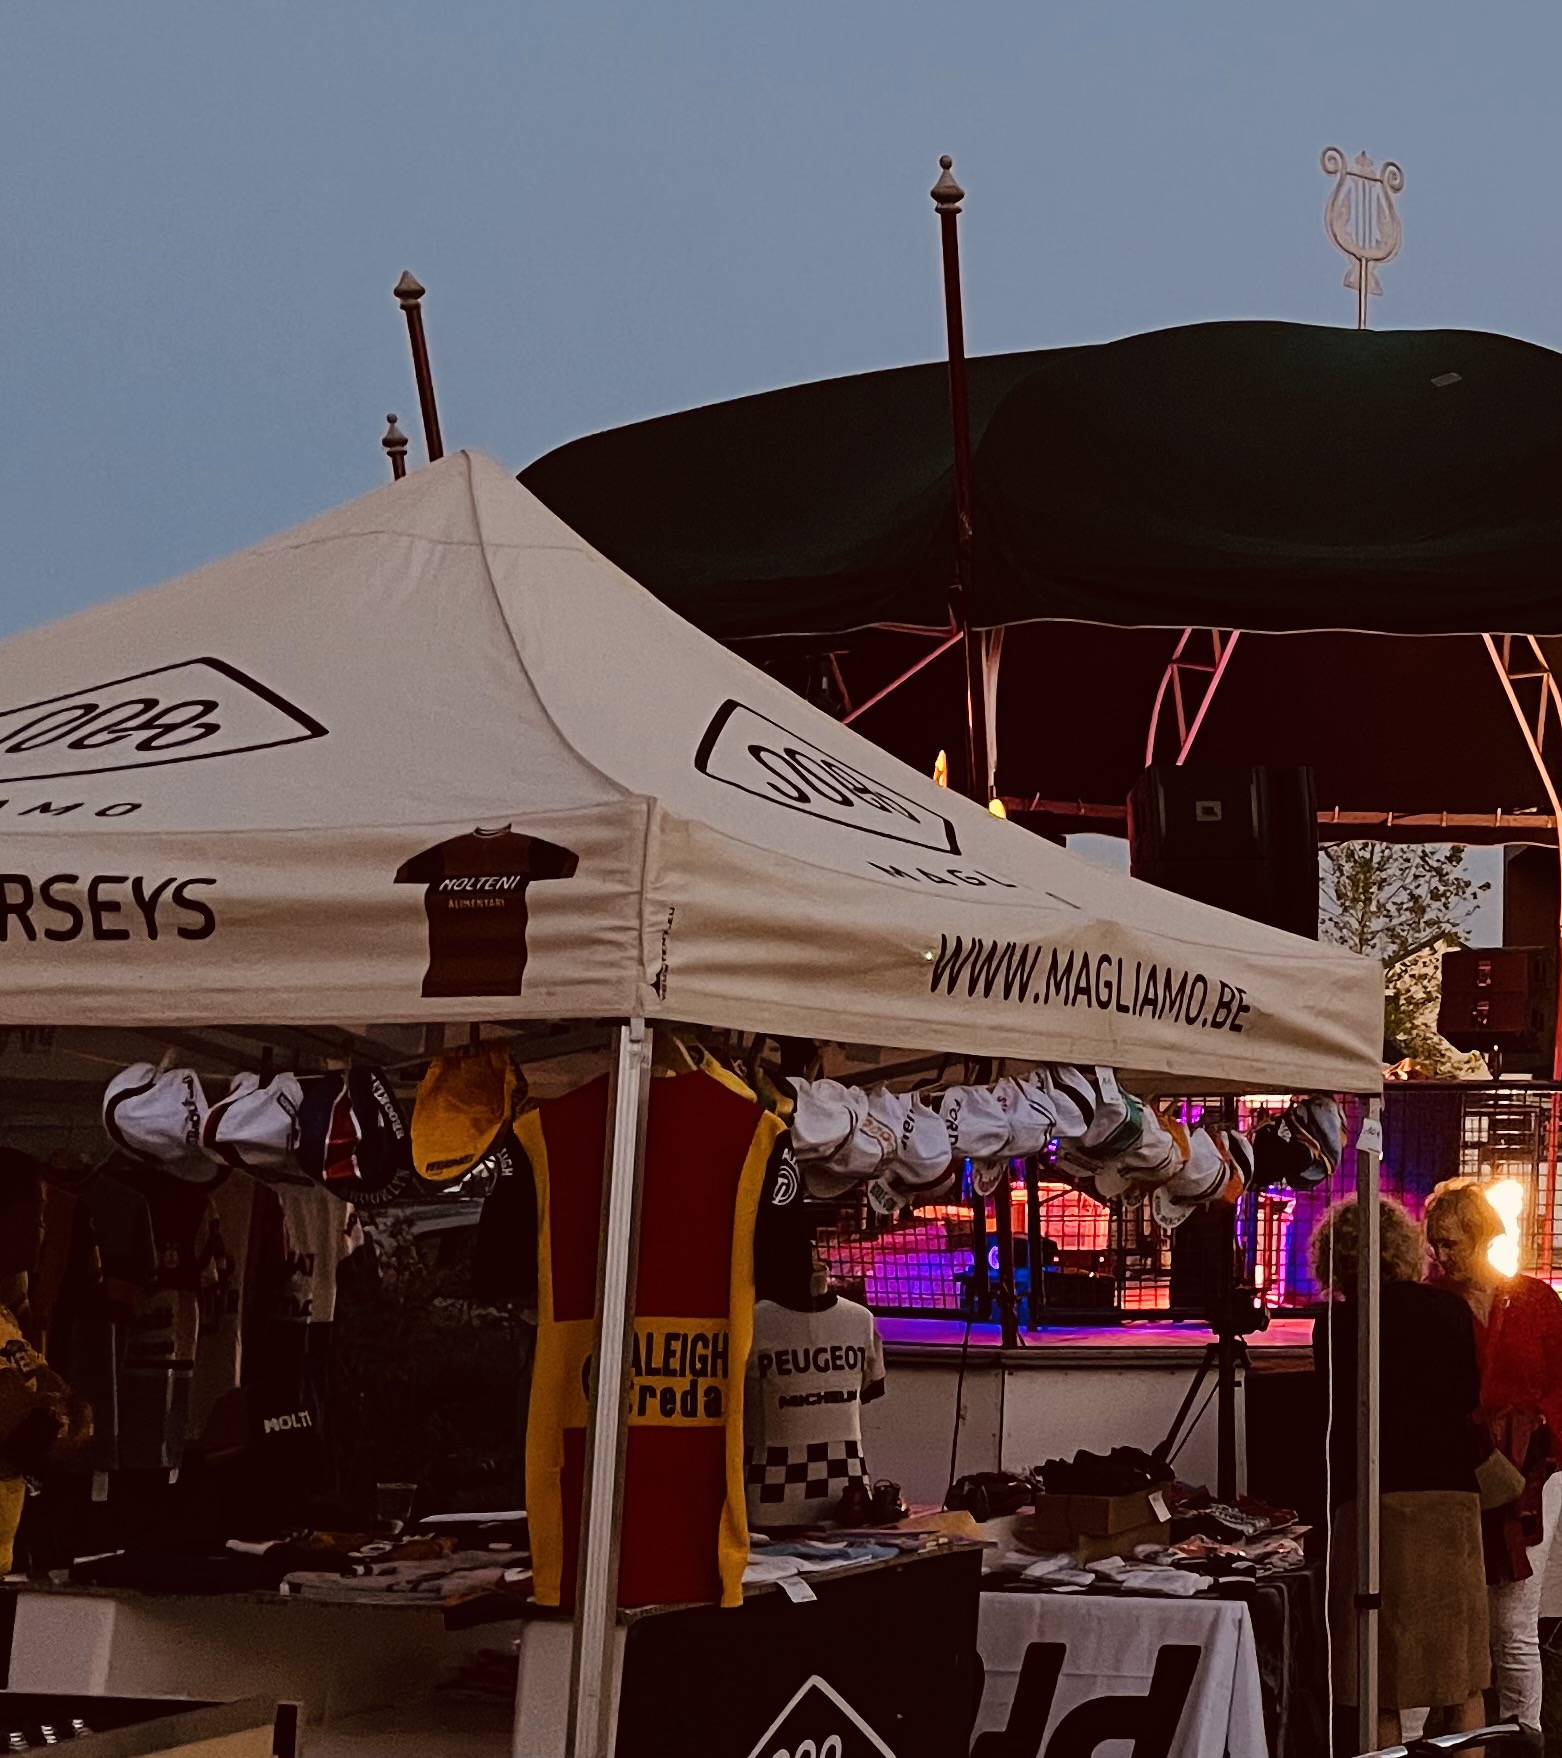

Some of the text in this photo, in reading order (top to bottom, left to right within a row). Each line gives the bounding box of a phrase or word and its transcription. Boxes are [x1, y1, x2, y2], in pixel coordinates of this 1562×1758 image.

[439, 874, 521, 892] MOLTENI
[0, 873, 217, 942] RSEYS
[930, 933, 1251, 1033] WWW.MAGLIAMO.BE
[631, 1332, 729, 1379] ALEIGH
[758, 1345, 866, 1378] PEUGEOT
